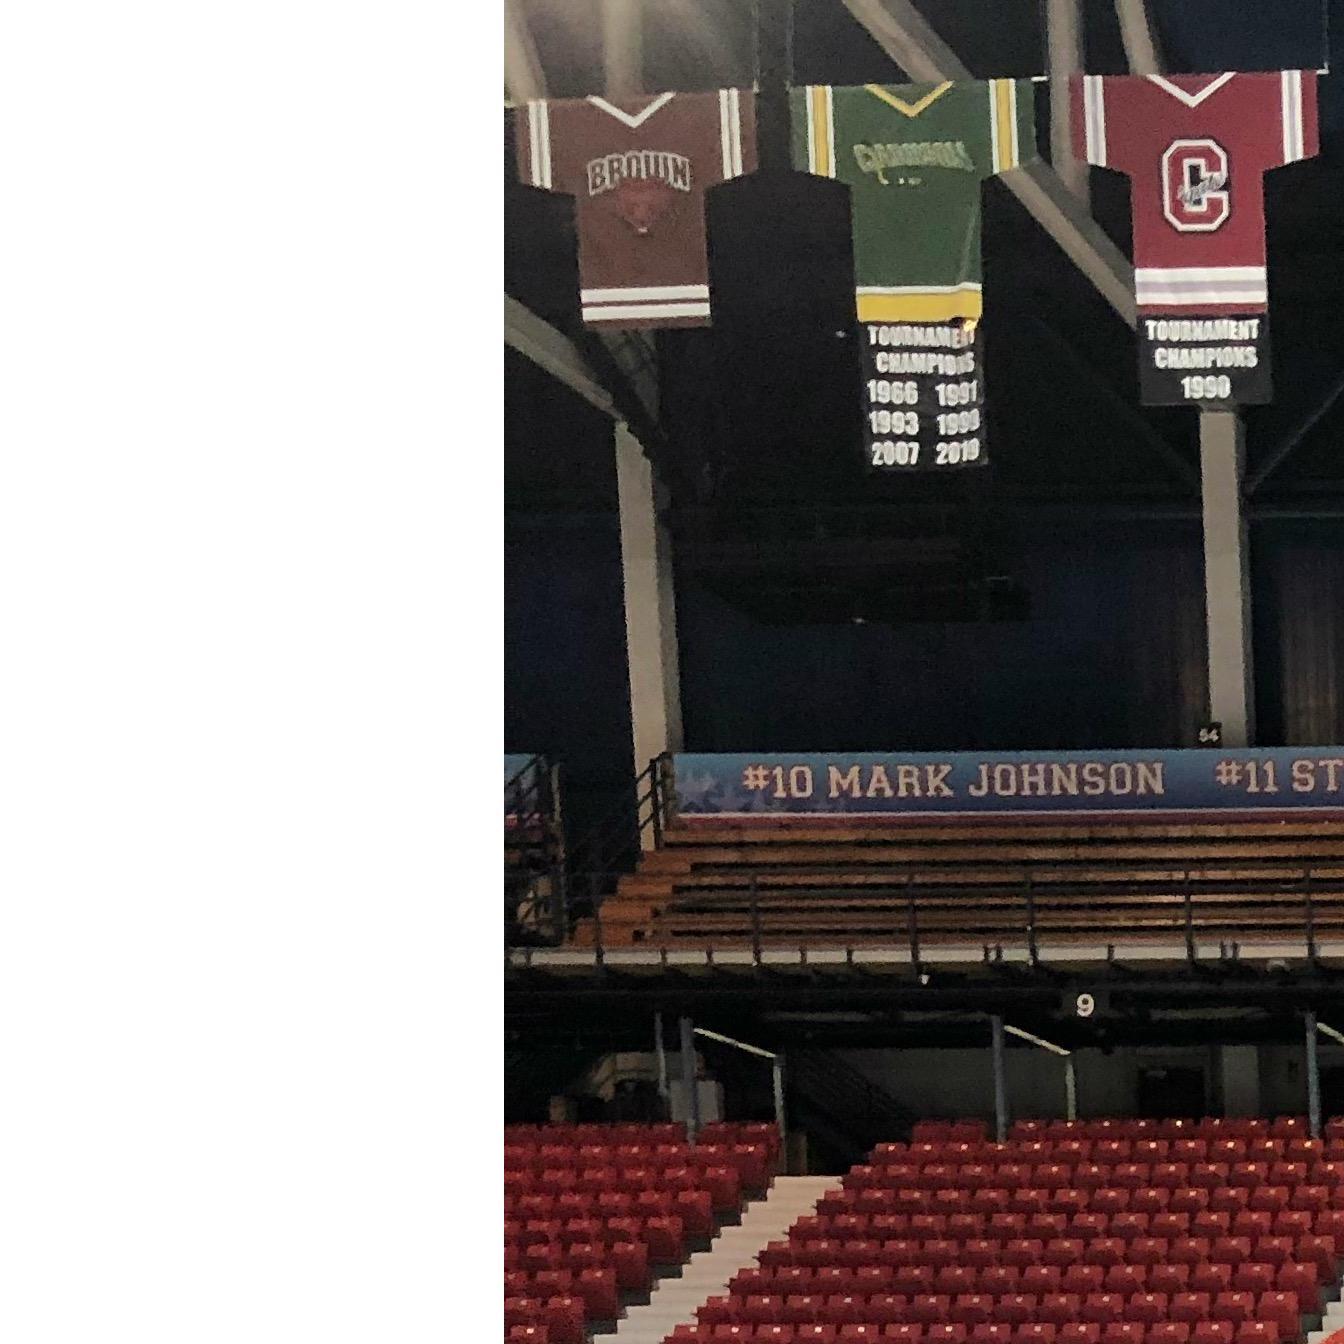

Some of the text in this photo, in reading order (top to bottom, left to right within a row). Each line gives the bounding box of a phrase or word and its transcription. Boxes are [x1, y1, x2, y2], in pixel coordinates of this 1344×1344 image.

[587, 149, 691, 196] BROWN
[1161, 138, 1230, 232] C
[1144, 318, 1260, 342] TOURNAMENT
[876, 351, 976, 376] CHAMPIONS
[1154, 345, 1259, 370] CHAMPIONS
[867, 379, 919, 405] 1966
[1181, 374, 1231, 399] 1990
[871, 440, 920, 466] 2007
[742, 761, 1165, 799] #10 MARK JOHNSON
[1214, 758, 1280, 793] #11
[1075, 993, 1096, 1019] 9
